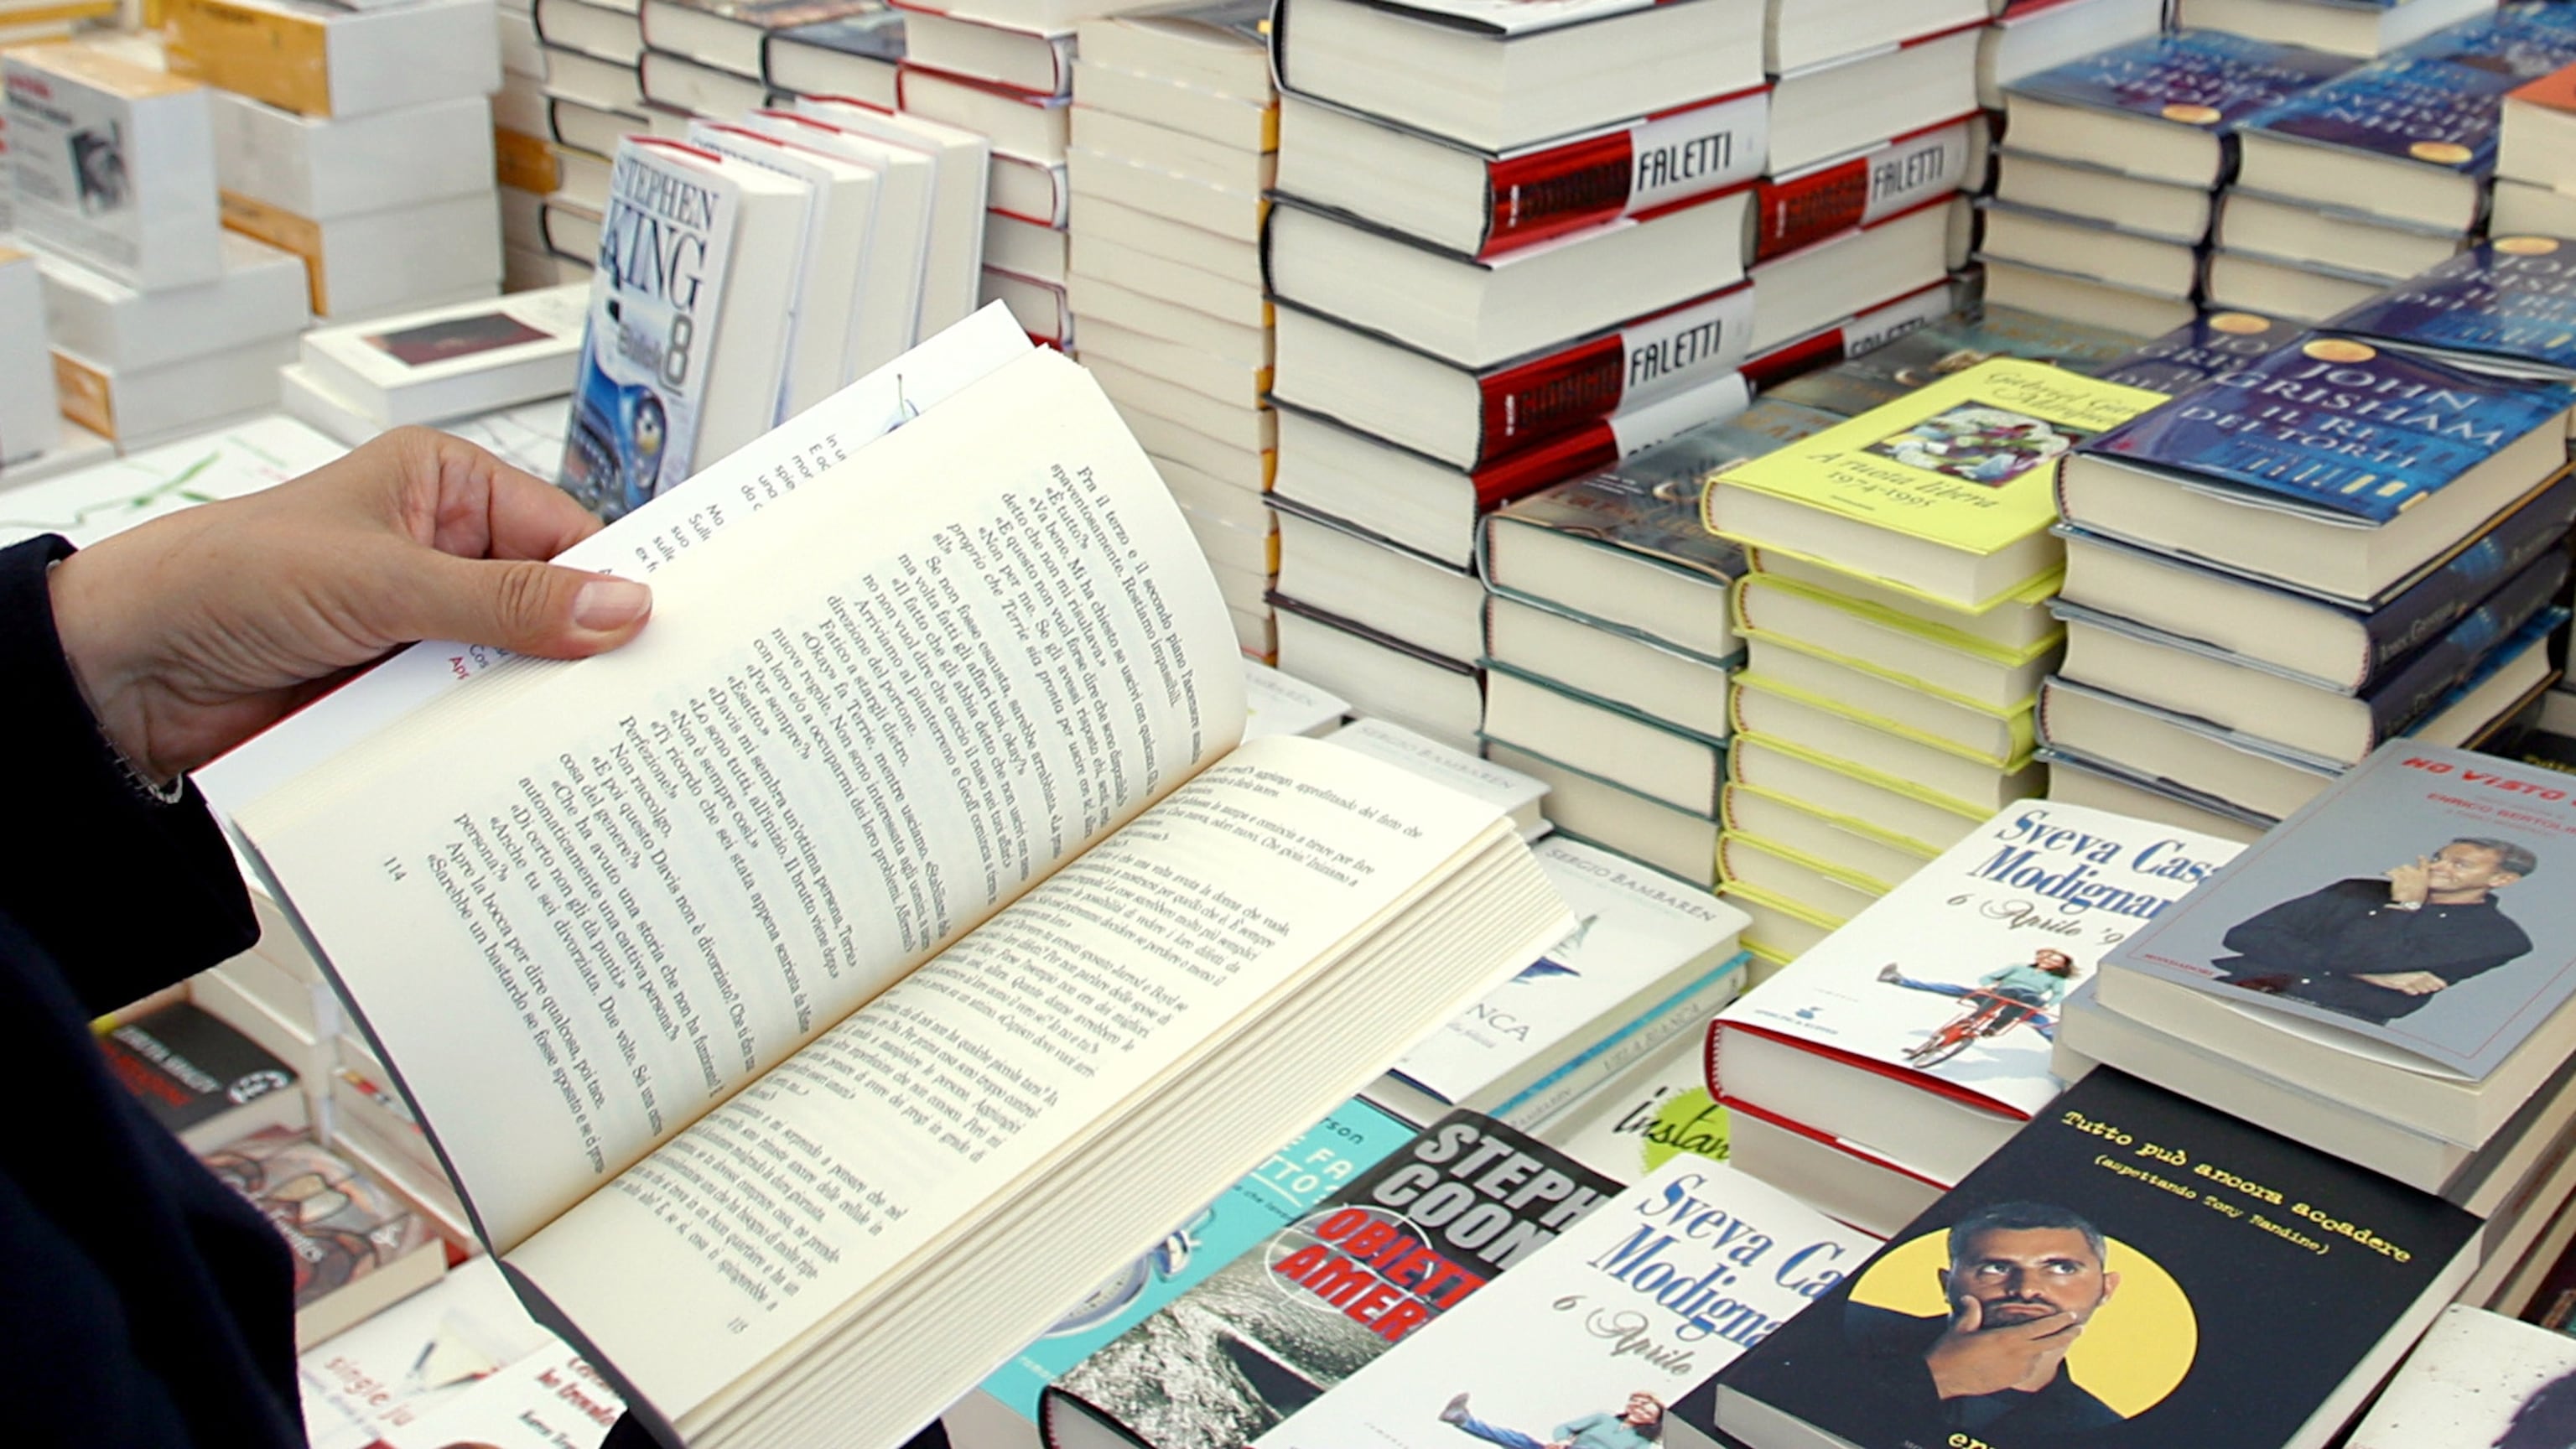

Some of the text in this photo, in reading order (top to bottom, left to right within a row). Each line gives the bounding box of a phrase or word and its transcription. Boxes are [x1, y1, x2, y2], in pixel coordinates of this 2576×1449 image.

[616, 153, 719, 231] STEPHEN
[1638, 131, 1732, 191] FALETTI
[1872, 146, 1945, 203] FALETTI
[599, 198, 707, 311] KING
[663, 314, 693, 387] 8
[1629, 319, 1722, 387] FALETTI
[2298, 362, 2480, 411] JOHN
[2180, 406, 2419, 469] DEI TORTI
[2214, 371, 2504, 446] GRISHAM
[2262, 406, 2376, 439] IL RE
[670, 525, 689, 548] suo
[1050, 463, 1124, 578] spaventosamente.
[1056, 504, 1089, 550] tutto?»
[1076, 465, 1097, 493] Fra
[1094, 494, 1110, 508] il
[1104, 510, 1130, 546] terzo
[1134, 560, 1150, 575] il
[1142, 578, 1173, 630] secondo
[1164, 631, 1187, 669] piano
[924, 555, 1011, 699] Se non fosse esausta,
[945, 522, 1086, 776] proprio che Terrie sia pronta per uscire
[978, 526, 1084, 706] «Non per me. Se gli avessi
[726, 675, 770, 736] «Esatto.»
[801, 631, 837, 680] «Okay»
[833, 681, 849, 699] fa
[845, 698, 875, 750] Terrie,
[873, 751, 905, 802] mentre
[608, 741, 672, 839] Non raccolgo.
[618, 714, 678, 799] Perfezione!»
[2461, 769, 2568, 802] VISTO
[383, 856, 407, 881] 114
[453, 812, 509, 882] persona?»
[510, 803, 535, 831] «Di
[525, 829, 555, 868] certo
[548, 866, 573, 898] non
[564, 897, 591, 919] gli
[580, 918, 601, 940] dà
[599, 776, 628, 802] poi
[618, 802, 655, 850] questo
[649, 847, 681, 895] Davis
[674, 894, 696, 925] non
[1995, 809, 2123, 865] Sveva
[1545, 848, 1717, 923] SERGIO BAMBARÉN
[1945, 892, 2125, 945] 6 Aprile '9
[427, 853, 558, 1066] «Sarebbe un bastardo se fosse
[489, 816, 636, 1067] «Anche tu sei divorziata. Due volte.
[1372, 1162, 1561, 1273] COON
[1414, 1122, 1615, 1233] STEPH
[2061, 1109, 2412, 1265] Tutto può ancora accadere
[2094, 1154, 2198, 1201] (aspettando
[2202, 1192, 2244, 1218] Tony
[1316, 1207, 1492, 1311] OBIETT
[1634, 1173, 1774, 1268] Sveva
[1552, 1294, 1696, 1376] 6 Aprile
